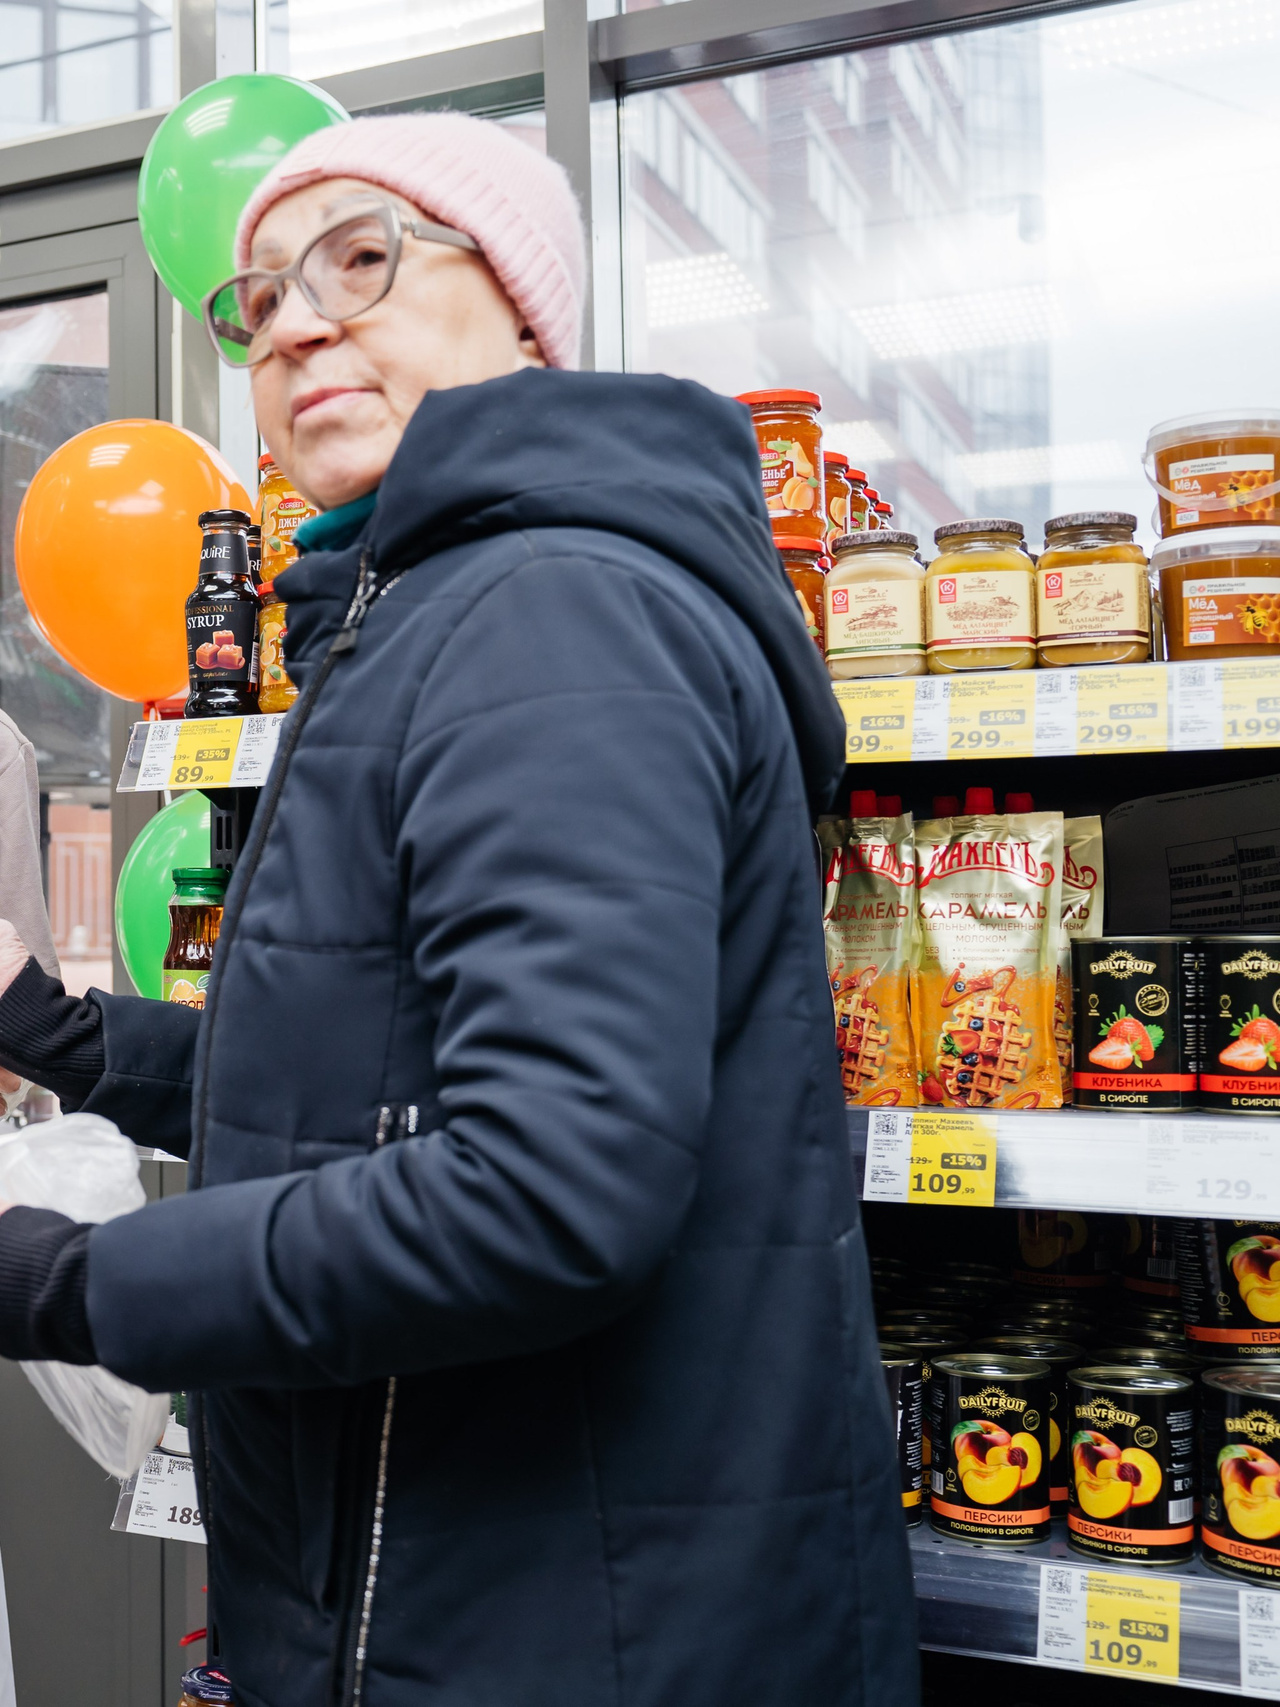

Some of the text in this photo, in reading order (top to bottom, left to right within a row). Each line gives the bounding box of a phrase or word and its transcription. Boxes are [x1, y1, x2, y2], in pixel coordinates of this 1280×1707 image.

[762, 468, 786, 480] ЕНЬЕ
[187, 614, 226, 629] SYRUP
[1112, 704, 1152, 716] -16%
[982, 711, 1020, 722] -16%
[863, 717, 901, 728] -16%
[198, 749, 226, 759] -35%
[950, 892, 982, 900] топпинг
[917, 901, 1048, 920] КАРАМЕЛЬ
[925, 922, 976, 932] ЦЕЛЬНЫМ
[956, 934, 1007, 944] МОЛОКОМ
[1089, 959, 1157, 975] DAILYFRUIT
[1092, 1077, 1163, 1088] КЛУБНИКА
[1099, 1094, 1149, 1104] В СИРОПЕ
[1231, 1097, 1239, 1106] В
[906, 1117, 938, 1125] Топпинг
[906, 1123, 974, 1132] Мягкая Карамель
[943, 1155, 982, 1167] -15%
[958, 1395, 1027, 1413] DAILYFRUIT
[1075, 1404, 1141, 1428] DAILYFRUIT
[167, 1505, 202, 1526] 189
[964, 1510, 1023, 1524] ПЕРСИКИ
[950, 1521, 998, 1535] ПОЛОВИНКИ
[1005, 1527, 1034, 1535] СИРОПЕ
[1077, 1521, 1132, 1542] ПЕРСИКИ
[1114, 1545, 1149, 1555] СИРОПЕ
[1265, 1567, 1273, 1576] В
[1122, 1622, 1164, 1639] -15%
